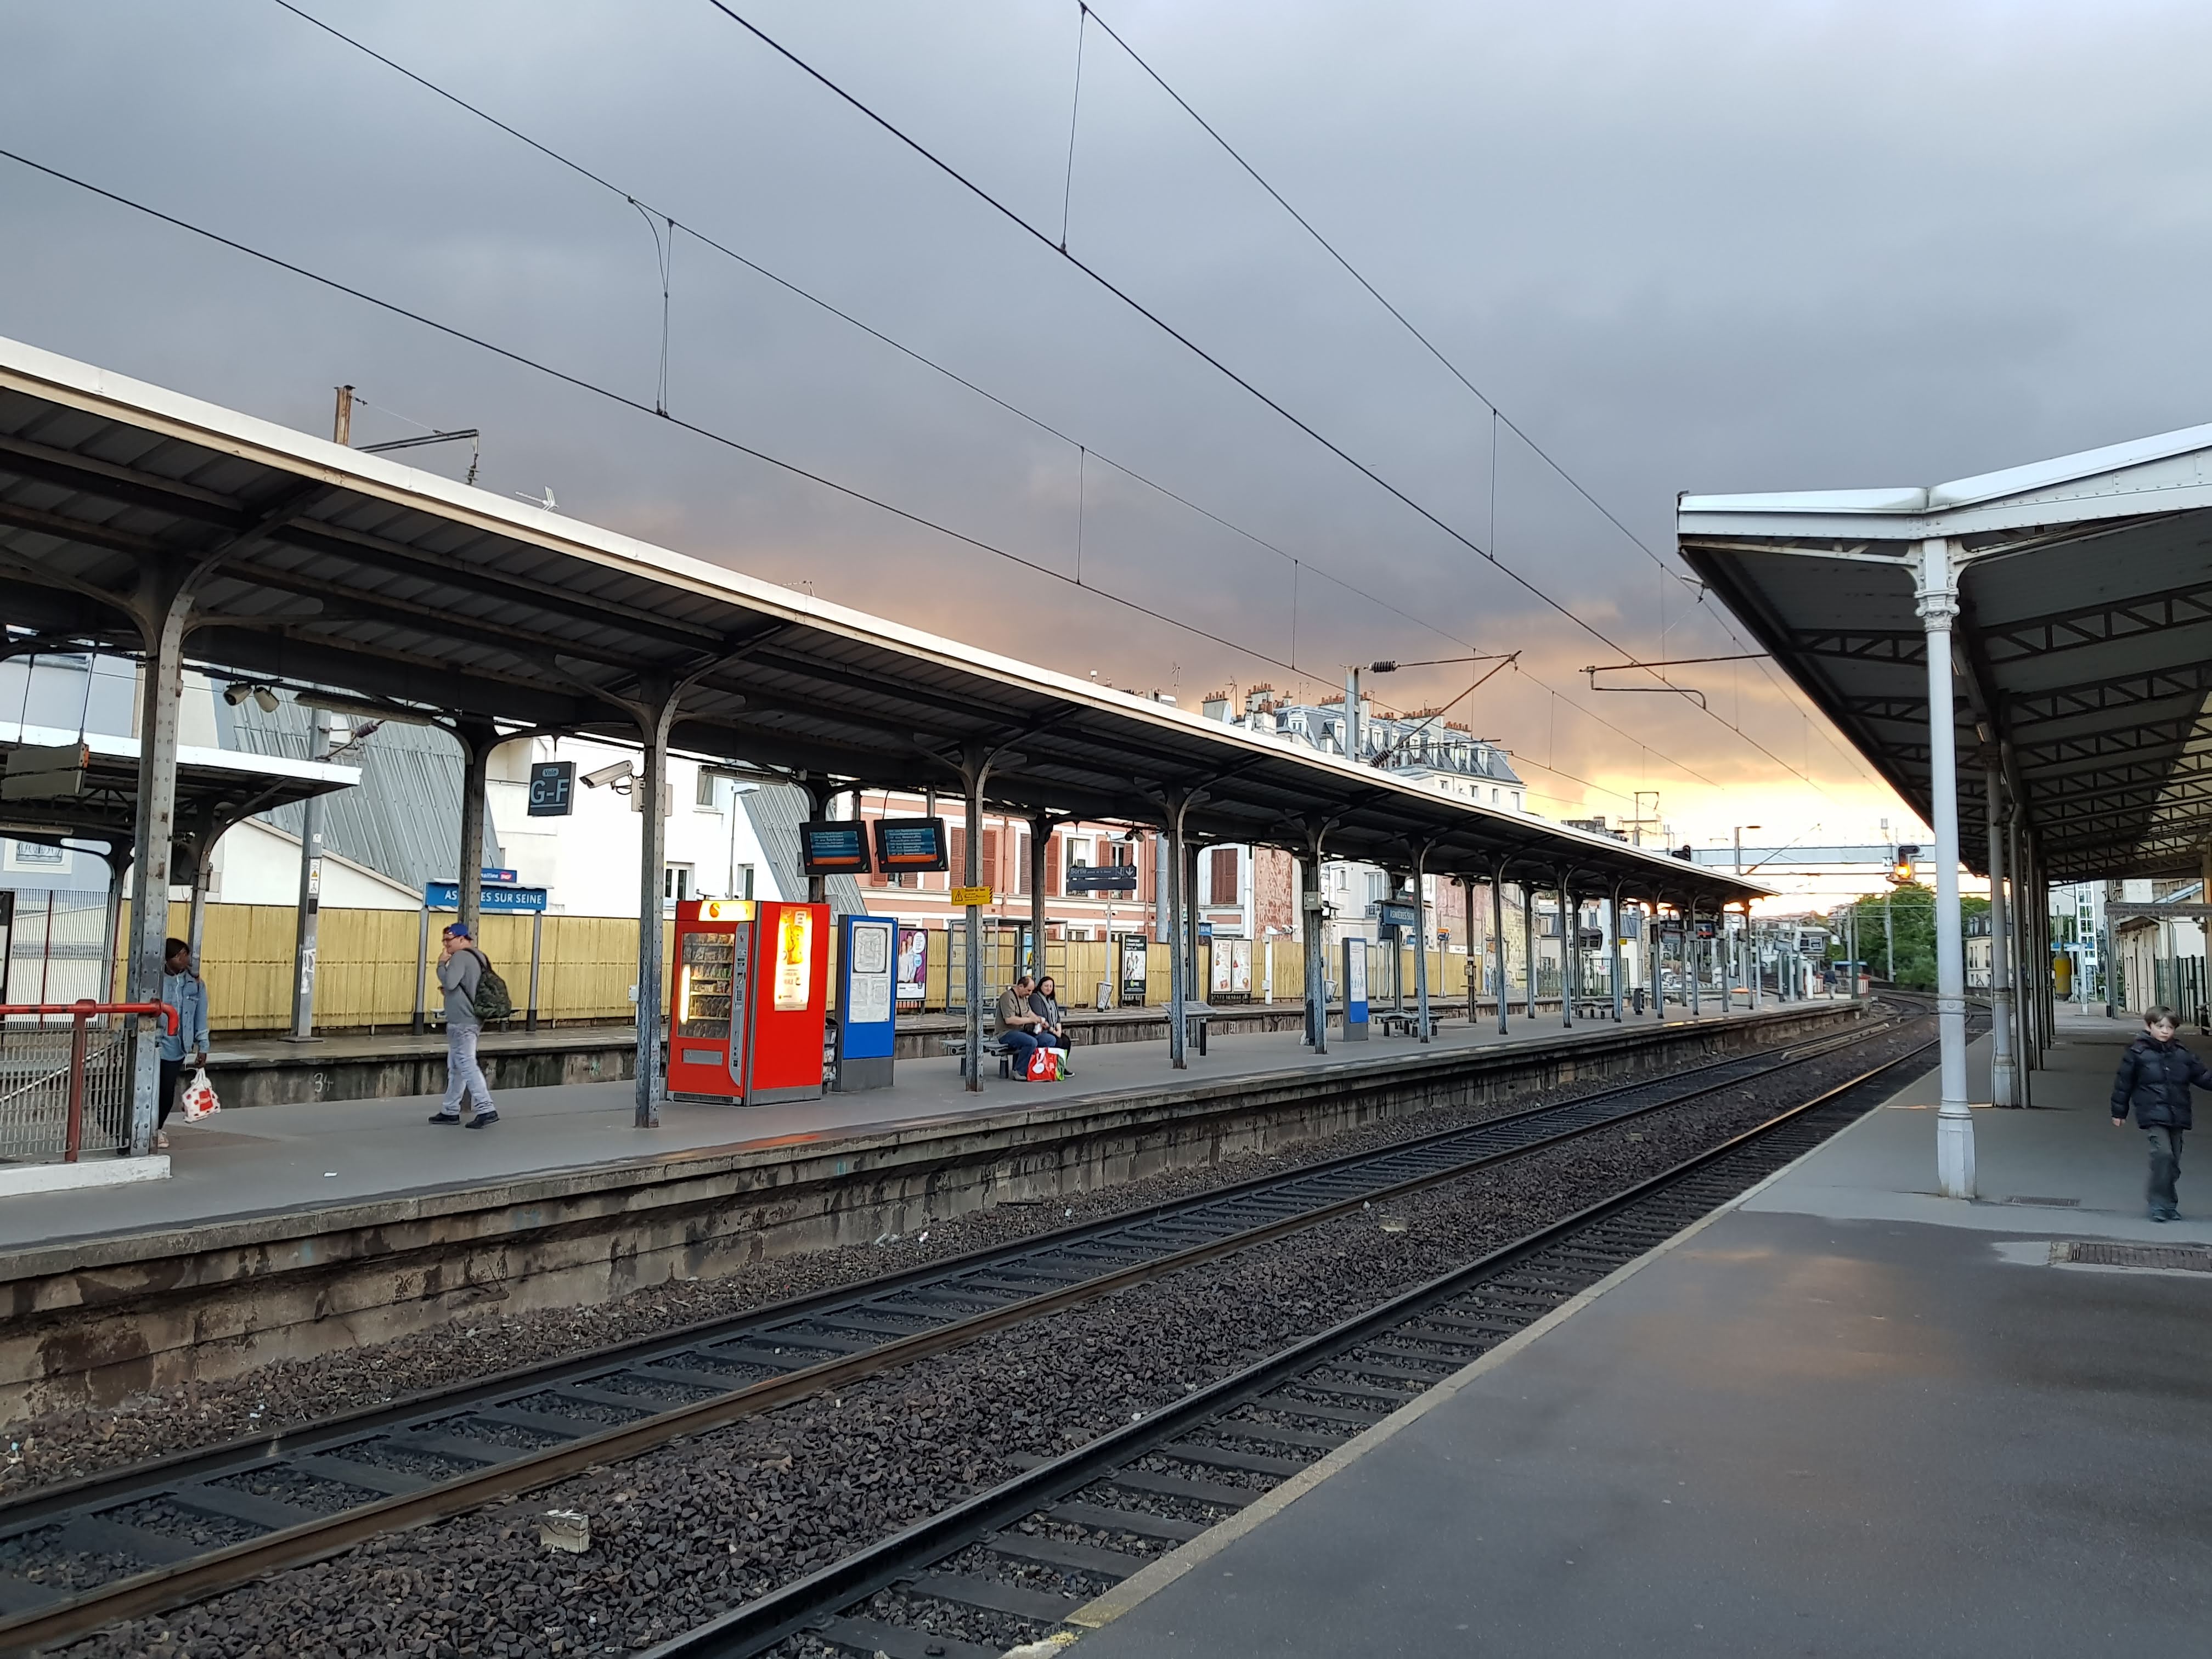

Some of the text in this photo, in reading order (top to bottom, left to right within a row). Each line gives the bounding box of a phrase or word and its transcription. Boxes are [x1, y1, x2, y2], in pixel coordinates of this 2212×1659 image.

[530, 778, 570, 804] G-F
[494, 893, 513, 903] SUR
[516, 894, 542, 905] SEINE
[314, 1073, 334, 1093] 34
